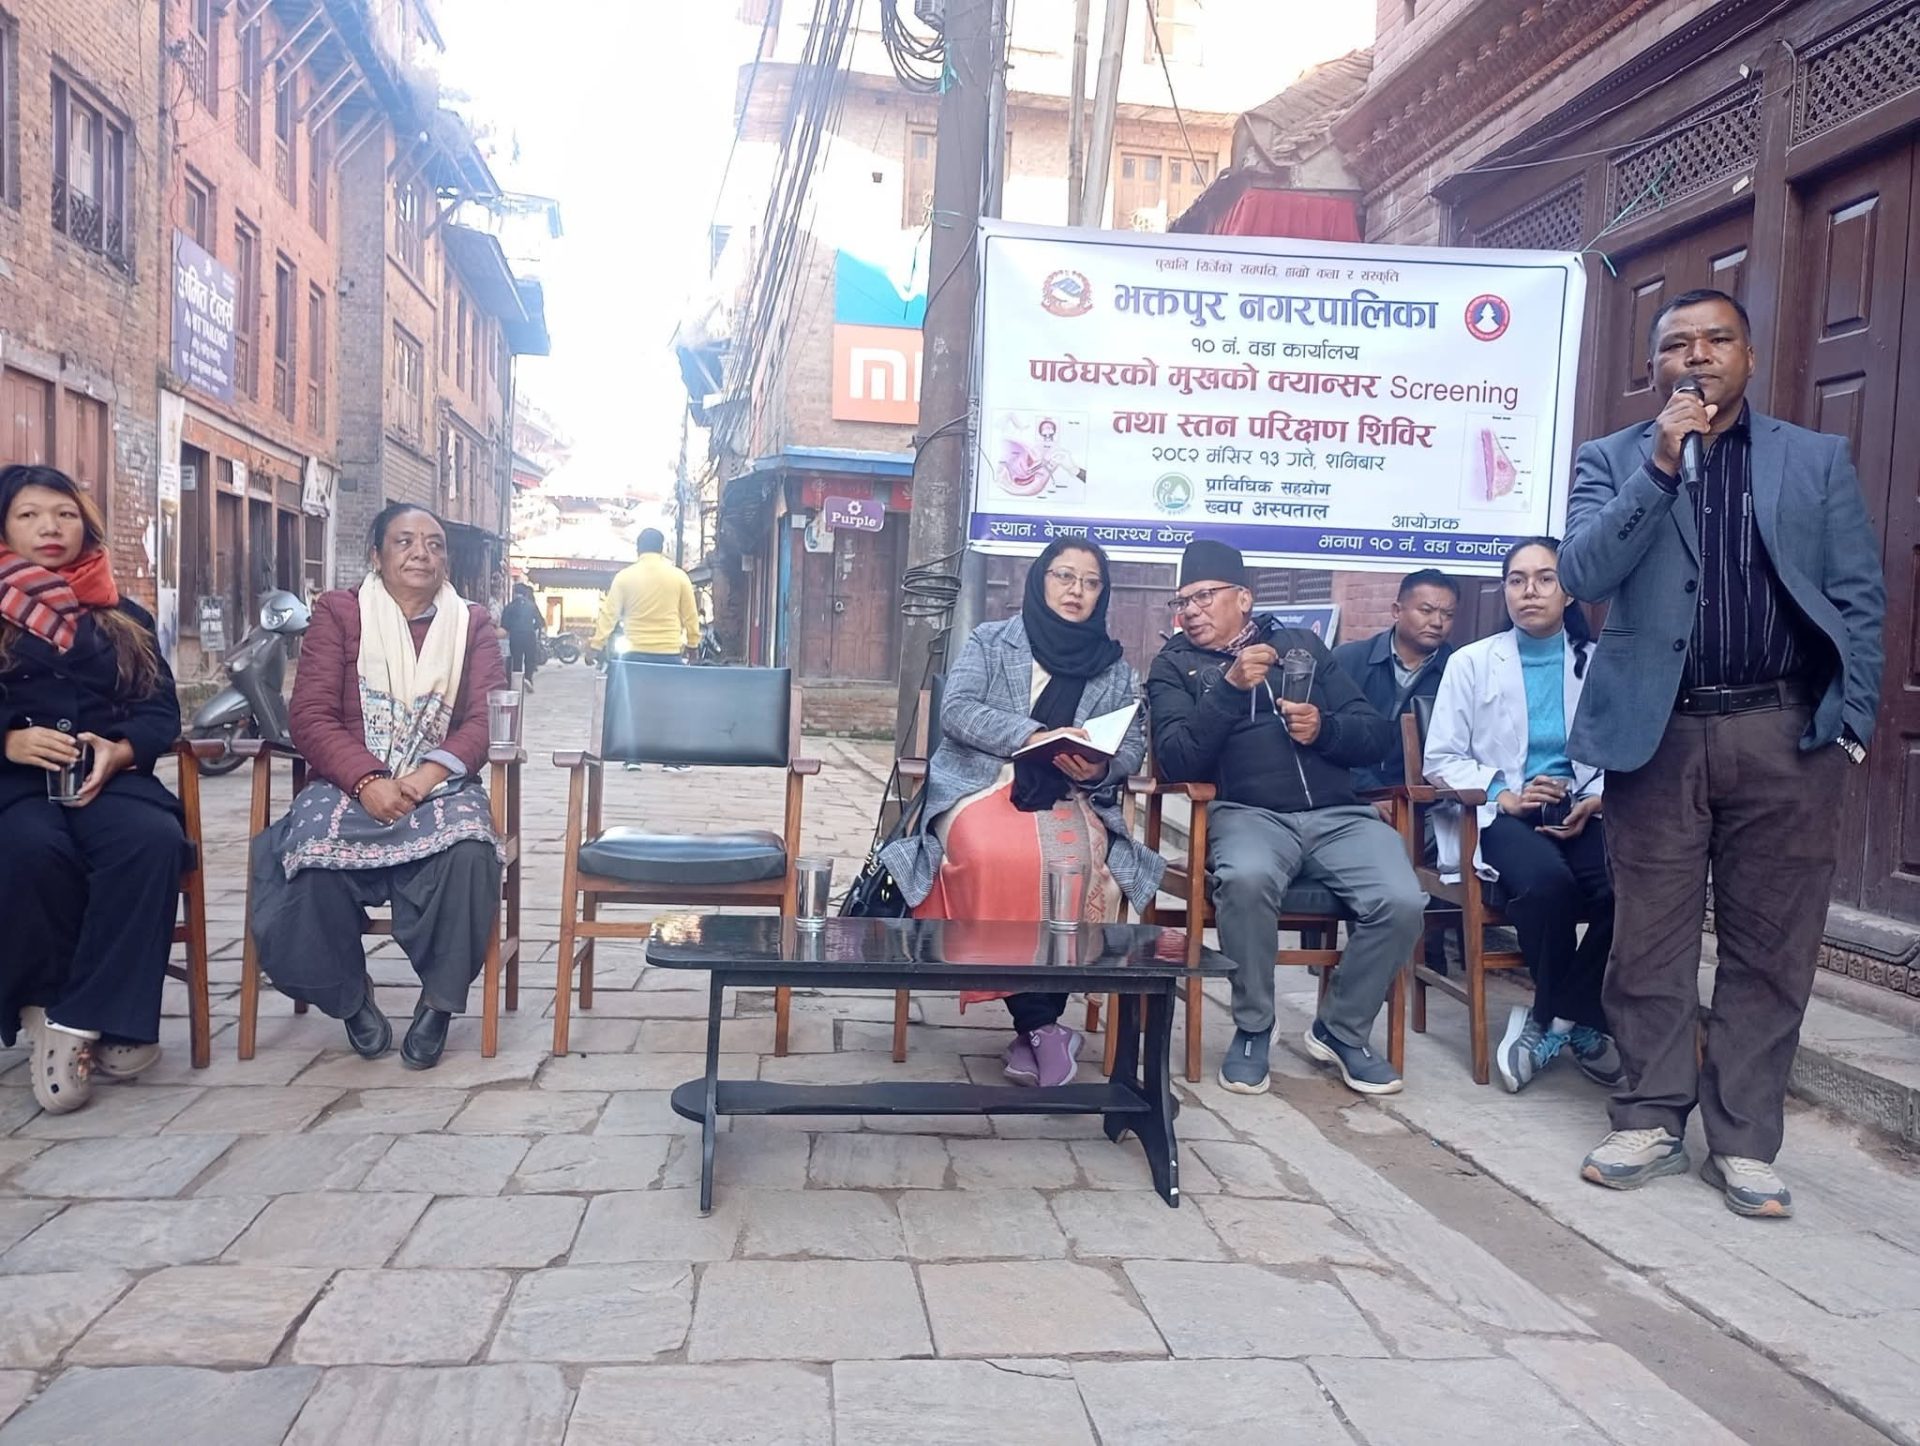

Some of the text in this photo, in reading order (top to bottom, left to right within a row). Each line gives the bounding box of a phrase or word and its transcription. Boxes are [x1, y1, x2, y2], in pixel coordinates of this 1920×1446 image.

[1114, 284, 1439, 329] भक्तपुर नगरपालिका
[1191, 337, 1215, 354] १०
[1248, 341, 1276, 357] वडा
[1283, 339, 1360, 360] कार्यालय
[1029, 353, 1519, 410] पाठेघरको मुखको क्यान्सर Screening
[1113, 410, 1436, 448] तथा स्तन परिक्षण शिविर
[1152, 446, 1199, 463] २०८२
[1206, 445, 1253, 465] मंसिर
[1259, 450, 1280, 467] १३
[1325, 451, 1386, 471] शनिबार
[1281, 480, 1331, 497] सहयोग
[831, 511, 876, 528] Purple
[1204, 500, 1243, 516] ख्वप
[1252, 501, 1330, 520] अस्पताल
[1392, 512, 1461, 530] आयोजक
[1369, 537, 1393, 551] १०
[1424, 539, 1452, 553] वडा
[1455, 538, 1515, 556] कार्याल
